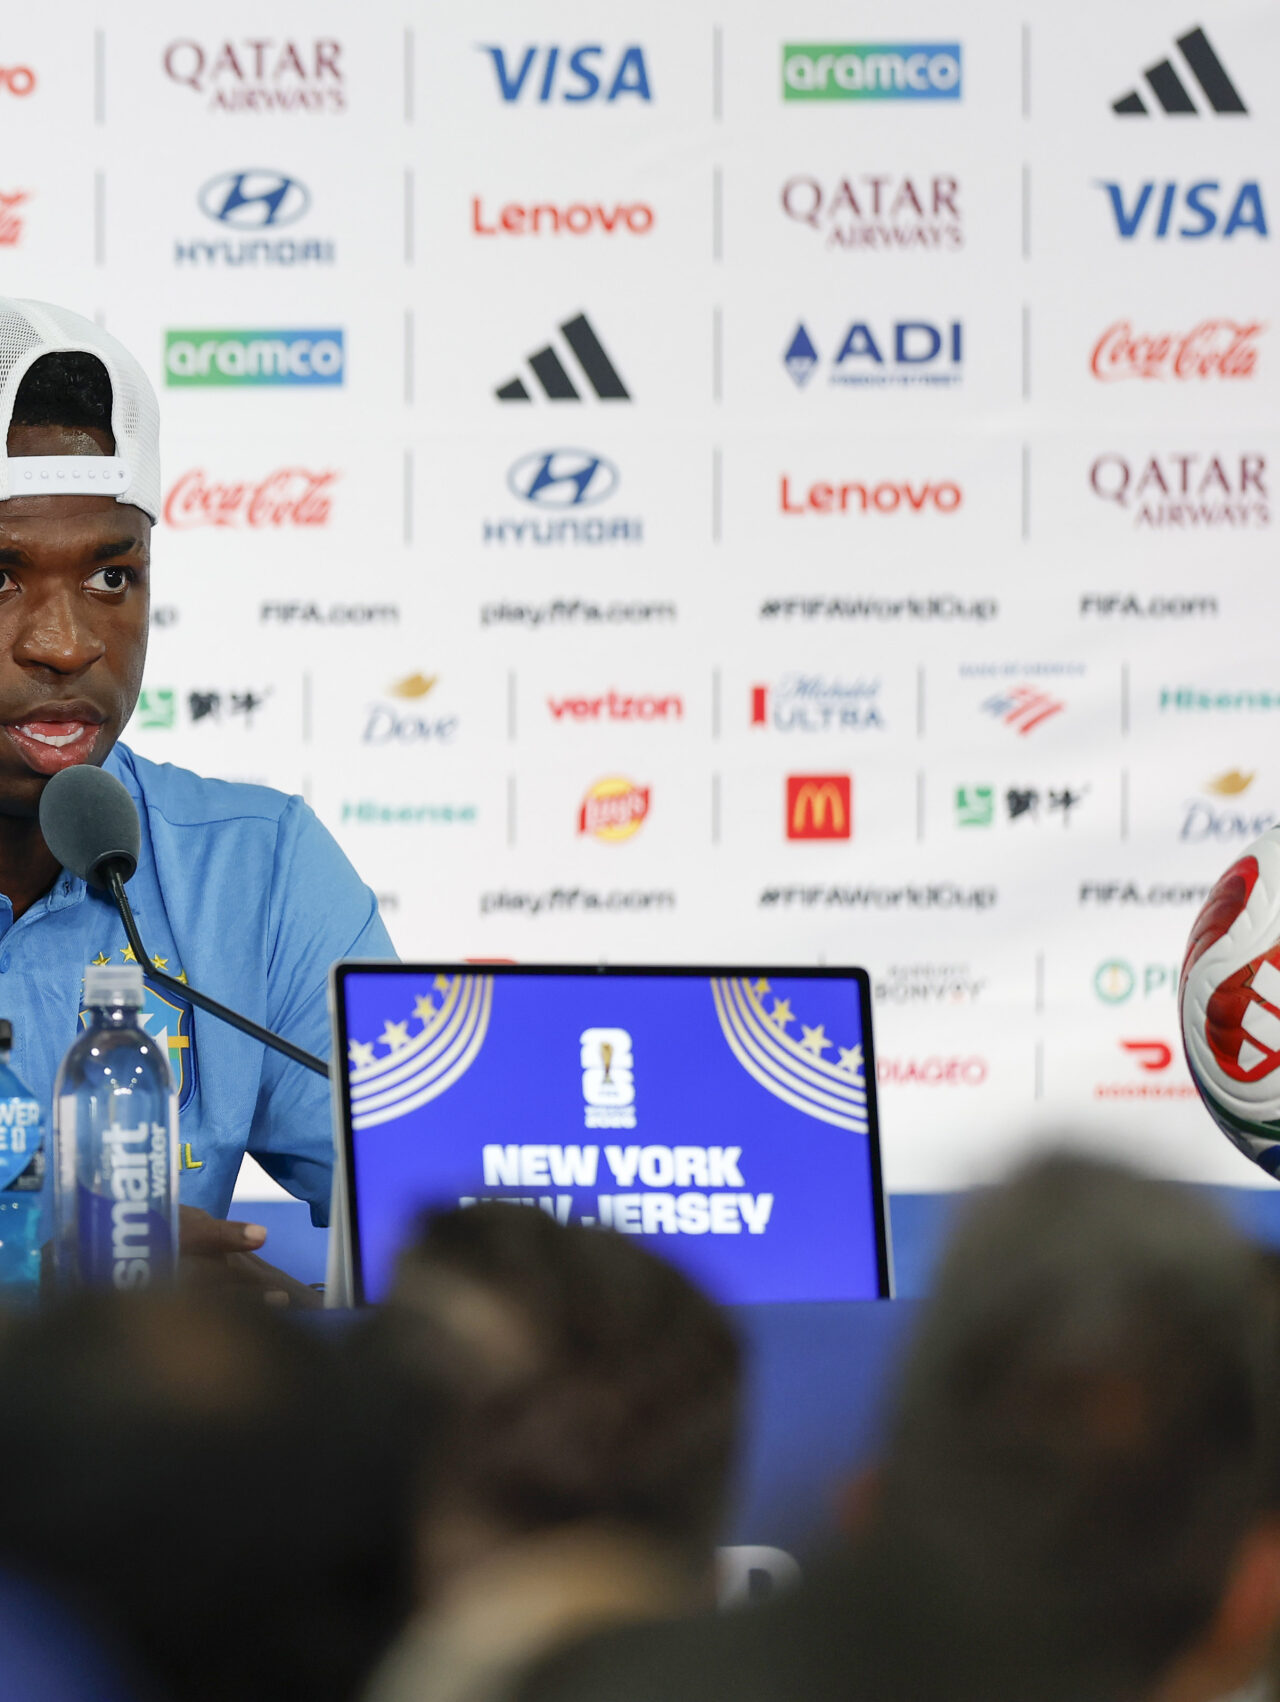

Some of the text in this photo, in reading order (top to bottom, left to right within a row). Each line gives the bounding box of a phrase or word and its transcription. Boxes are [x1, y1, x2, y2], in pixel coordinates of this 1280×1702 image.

[163, 39, 344, 91] QATAR
[475, 44, 654, 104] VISA
[785, 53, 959, 89] aramco
[209, 90, 347, 113] AIRWAYS
[472, 197, 654, 235] Lenovo
[781, 176, 961, 229] QATAR
[1096, 180, 1270, 240] VISA
[175, 239, 335, 266] HYUNDAI
[826, 227, 964, 250] AIRWAYS
[168, 341, 341, 376] aramco
[834, 321, 962, 365] ADI
[1089, 320, 1265, 380] Coca-Cola
[780, 476, 962, 514] Lenovo
[1089, 454, 1268, 506] QATAR
[163, 469, 338, 529] Coca-Cola
[1135, 503, 1272, 528] AIRWAYS
[483, 518, 643, 545] HYUNDAI
[260, 602, 399, 624] FIFA.com
[760, 597, 998, 621] #FIFAWorldCup
[1080, 594, 1218, 617] FIFA.com
[548, 690, 683, 720] verizon
[1159, 688, 1280, 711] Hisens
[362, 705, 458, 745] Dove
[774, 706, 885, 732] ULTRA
[341, 801, 477, 824] Hisense
[760, 885, 997, 910] #FIFAWorldCup
[1143, 964, 1180, 999] PI
[877, 1055, 986, 1088] DIAGEO
[150, 1121, 167, 1198] water
[483, 1144, 746, 1187] NEW YORK
[102, 1121, 151, 1292] smart
[581, 1193, 774, 1235] JERSEY
